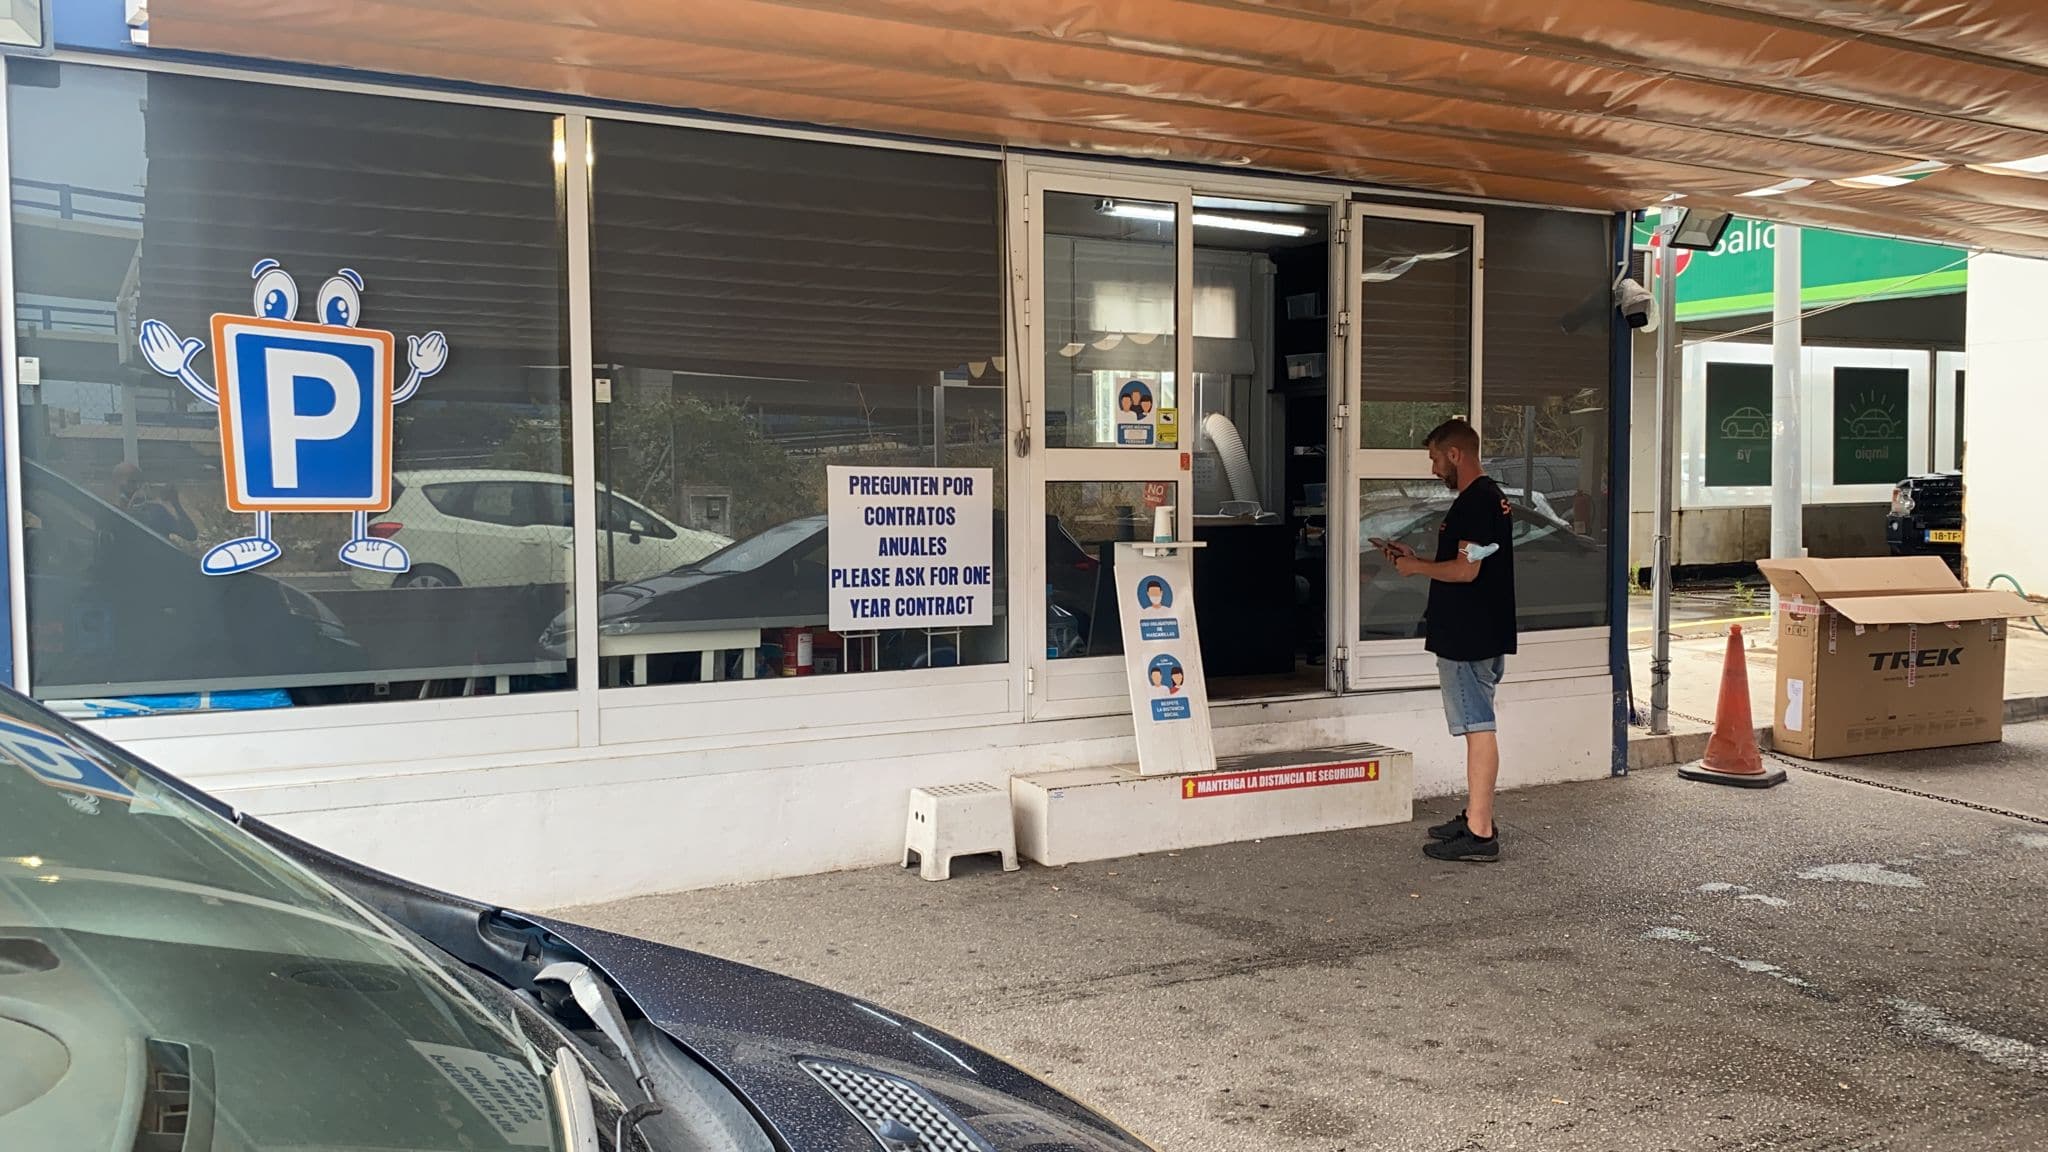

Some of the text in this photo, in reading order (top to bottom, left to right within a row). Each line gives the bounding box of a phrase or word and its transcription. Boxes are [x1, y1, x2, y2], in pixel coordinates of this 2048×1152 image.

[264, 347, 361, 489] P
[849, 475, 973, 496] PREGUNTEN POR
[1147, 483, 1164, 496] NO
[864, 506, 956, 526] CONTRATOS
[878, 536, 947, 557] ANUALES
[831, 566, 991, 588] PLEASE ASK FOR ONE
[850, 596, 974, 618] YEAR CONTRACT
[1867, 647, 1965, 671] TREK
[1197, 766, 1366, 794] MANTENGA LA DISTANCIA DE SEGURIDAD
